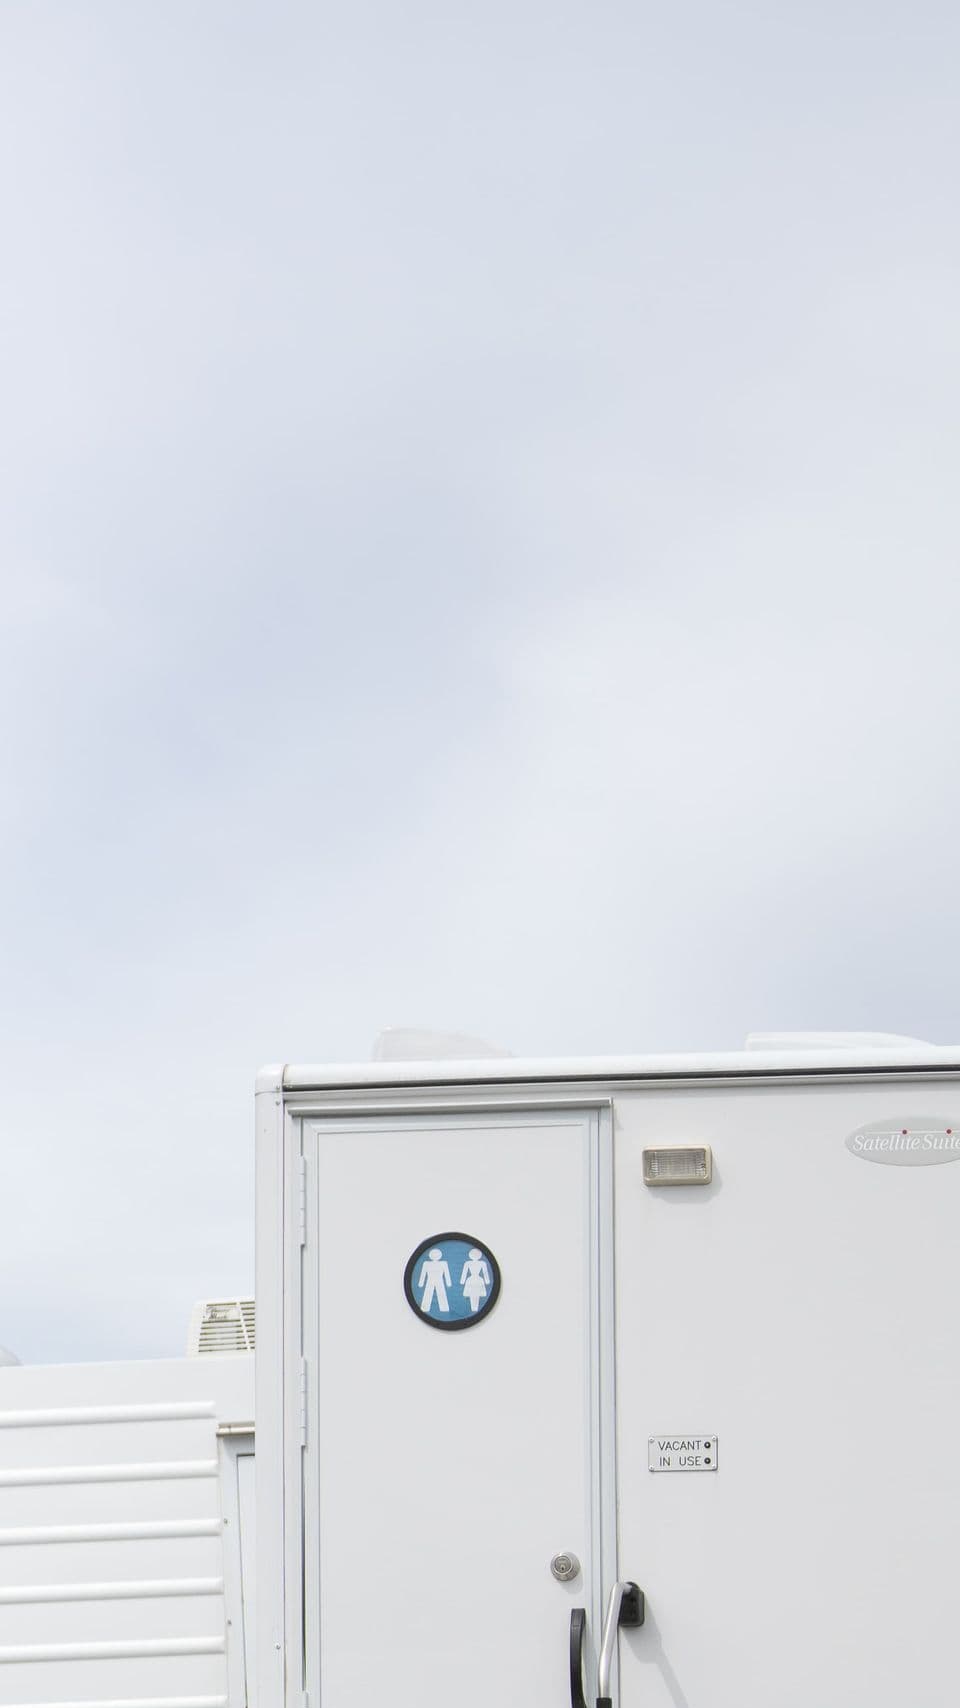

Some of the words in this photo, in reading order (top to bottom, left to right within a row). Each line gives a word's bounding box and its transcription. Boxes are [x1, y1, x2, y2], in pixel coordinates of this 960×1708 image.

[852, 1130, 921, 1151] Satellite
[657, 1440, 702, 1451] VACANT
[659, 1455, 671, 1467] IN
[679, 1455, 702, 1466] USE
